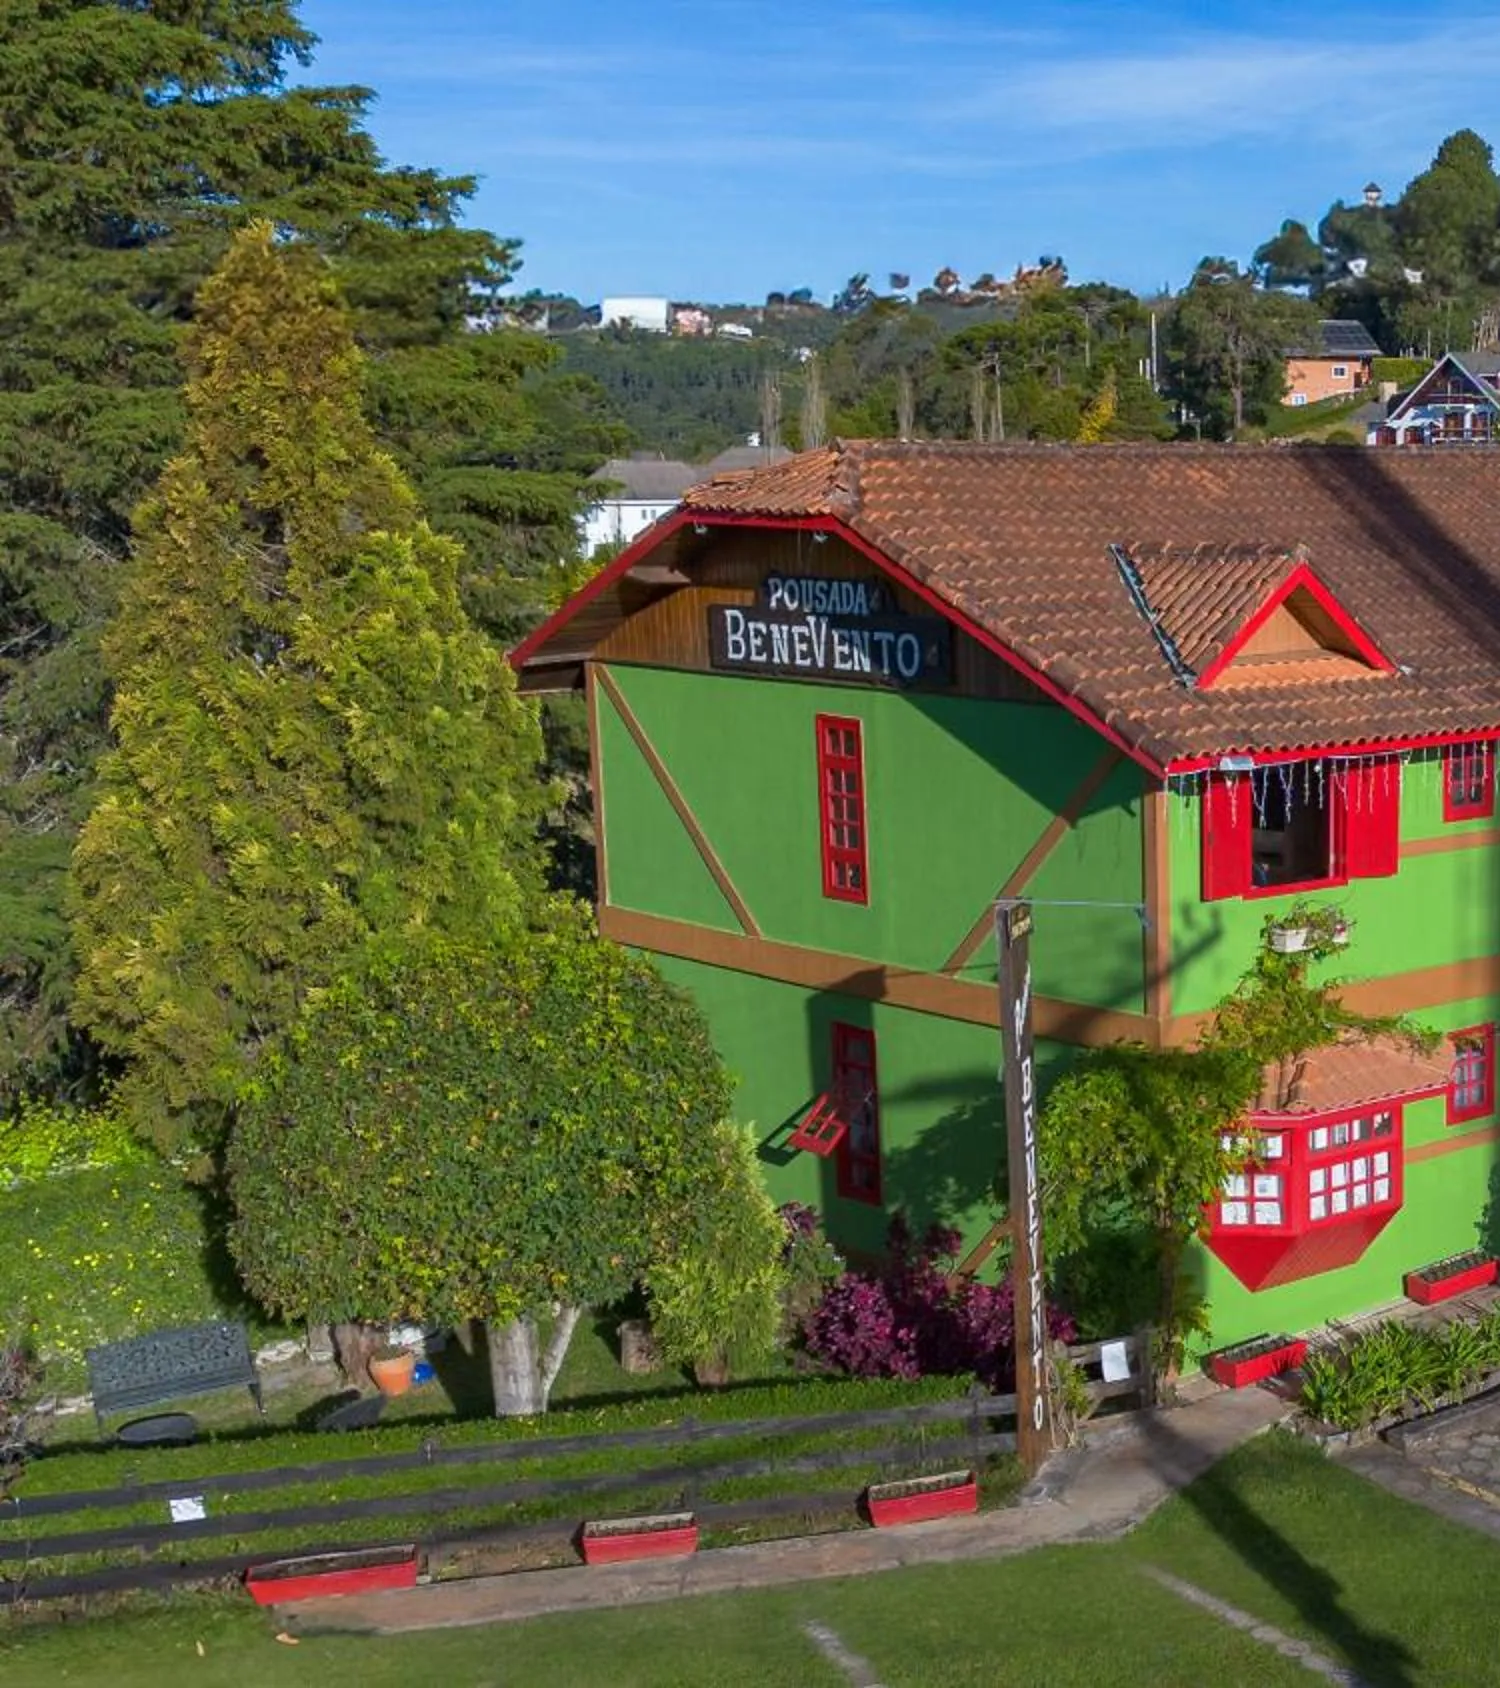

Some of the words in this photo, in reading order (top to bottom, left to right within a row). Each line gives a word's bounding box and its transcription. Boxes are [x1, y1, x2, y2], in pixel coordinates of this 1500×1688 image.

[768, 577, 870, 615] POUSADA
[724, 609, 920, 677] BENEVENTO
[1021, 1056, 1044, 1431] BENEVENTO
